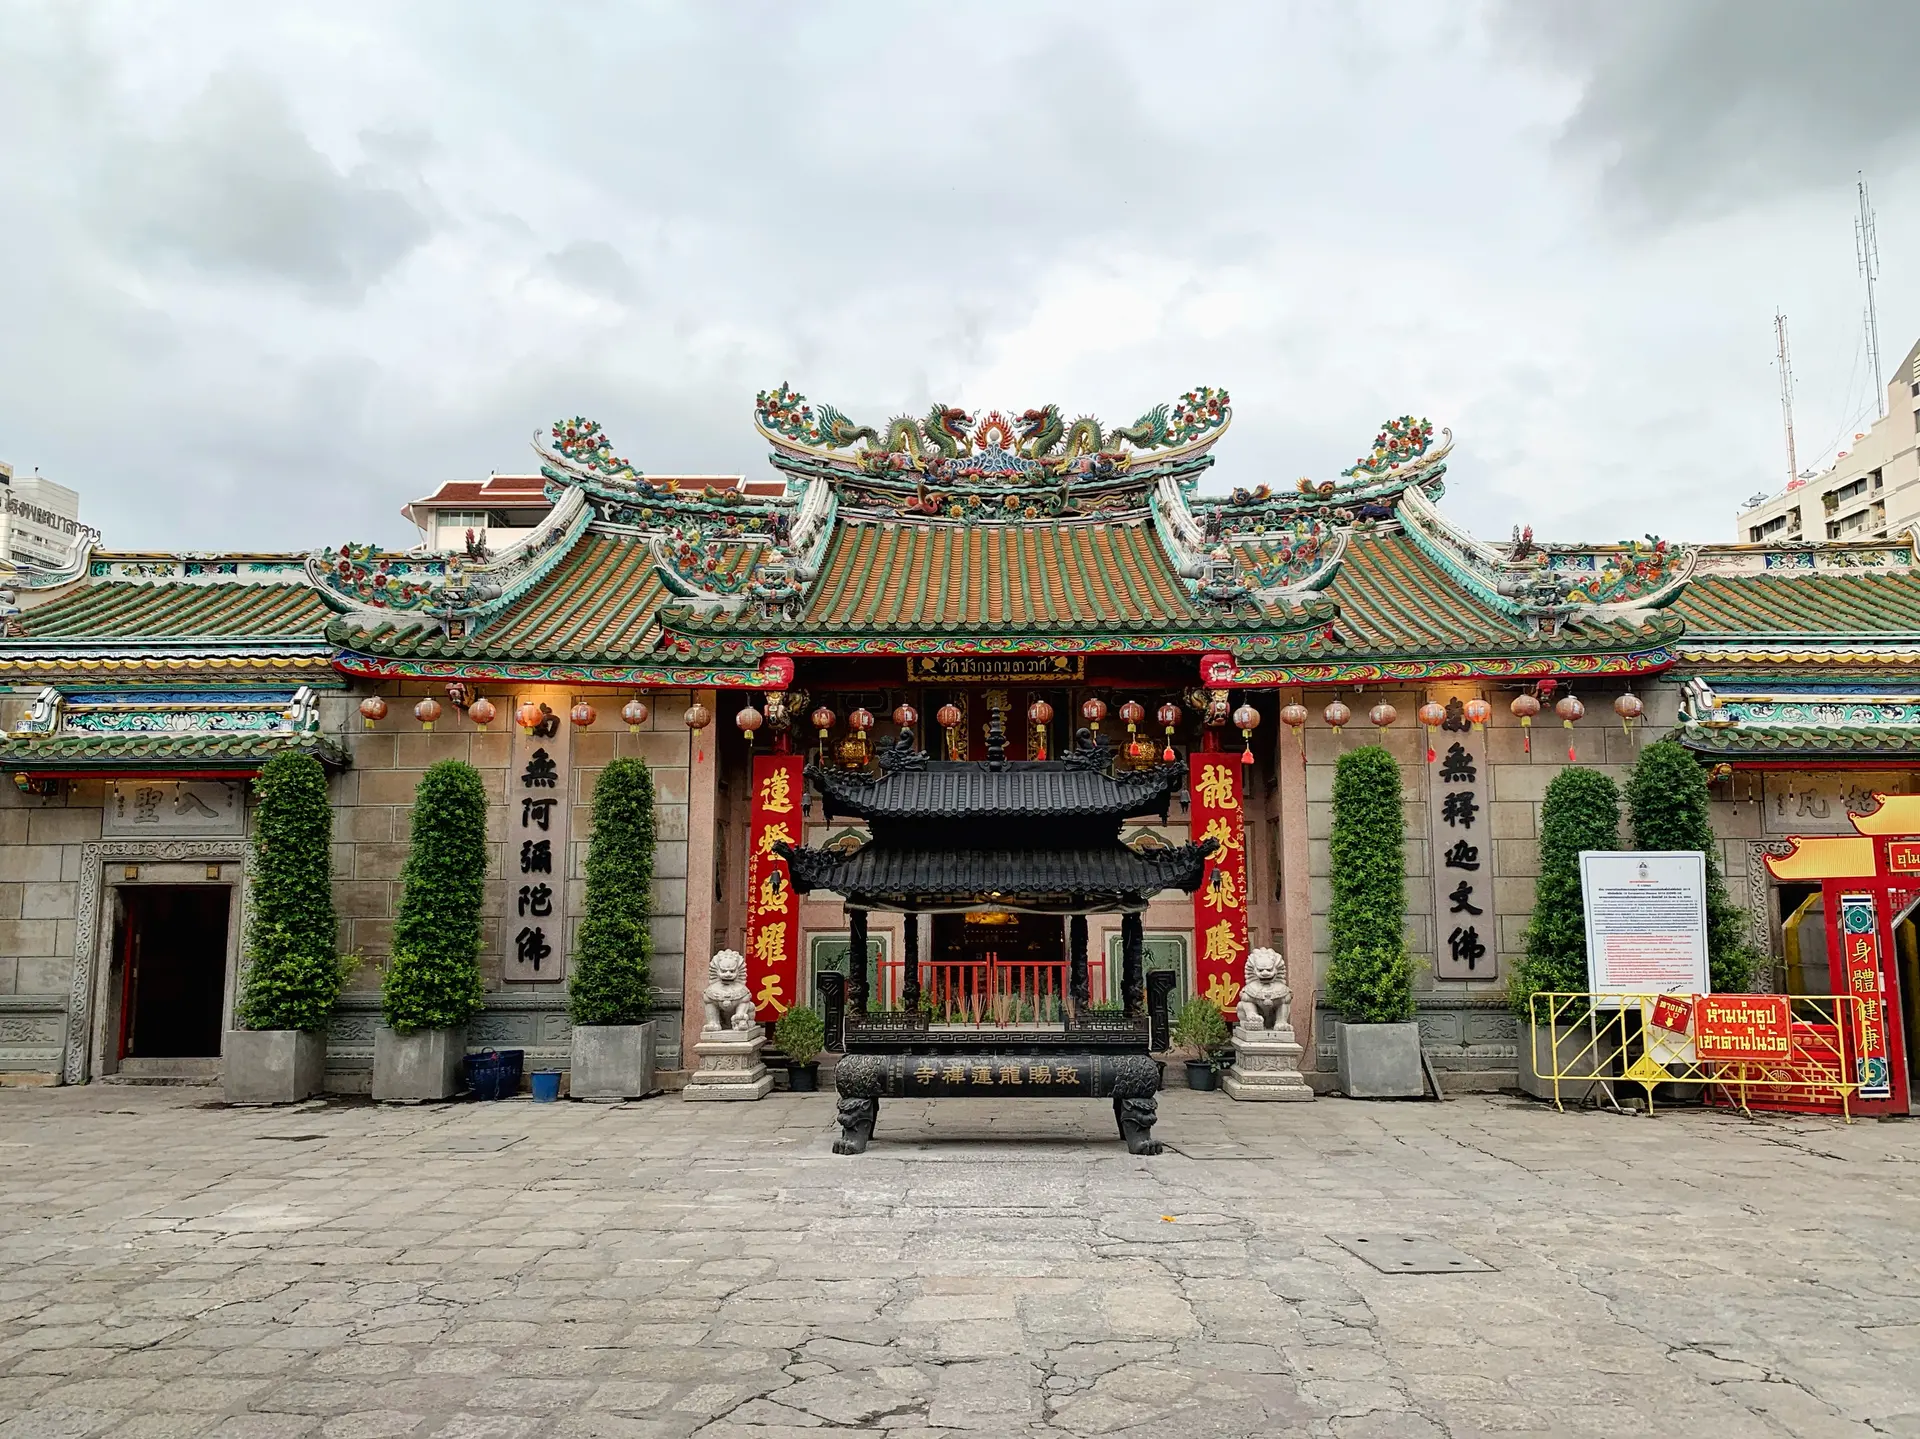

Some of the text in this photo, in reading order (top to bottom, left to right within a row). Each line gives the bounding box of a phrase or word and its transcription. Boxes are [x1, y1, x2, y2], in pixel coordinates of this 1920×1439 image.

[1659, 1000, 1688, 1015] ทางเข้า
[1851, 938, 1881, 1052] 身體健康
[1706, 1001, 1776, 1030] ห้ามนำธูป
[1699, 1027, 1788, 1051] เข้าด้านในวัด
